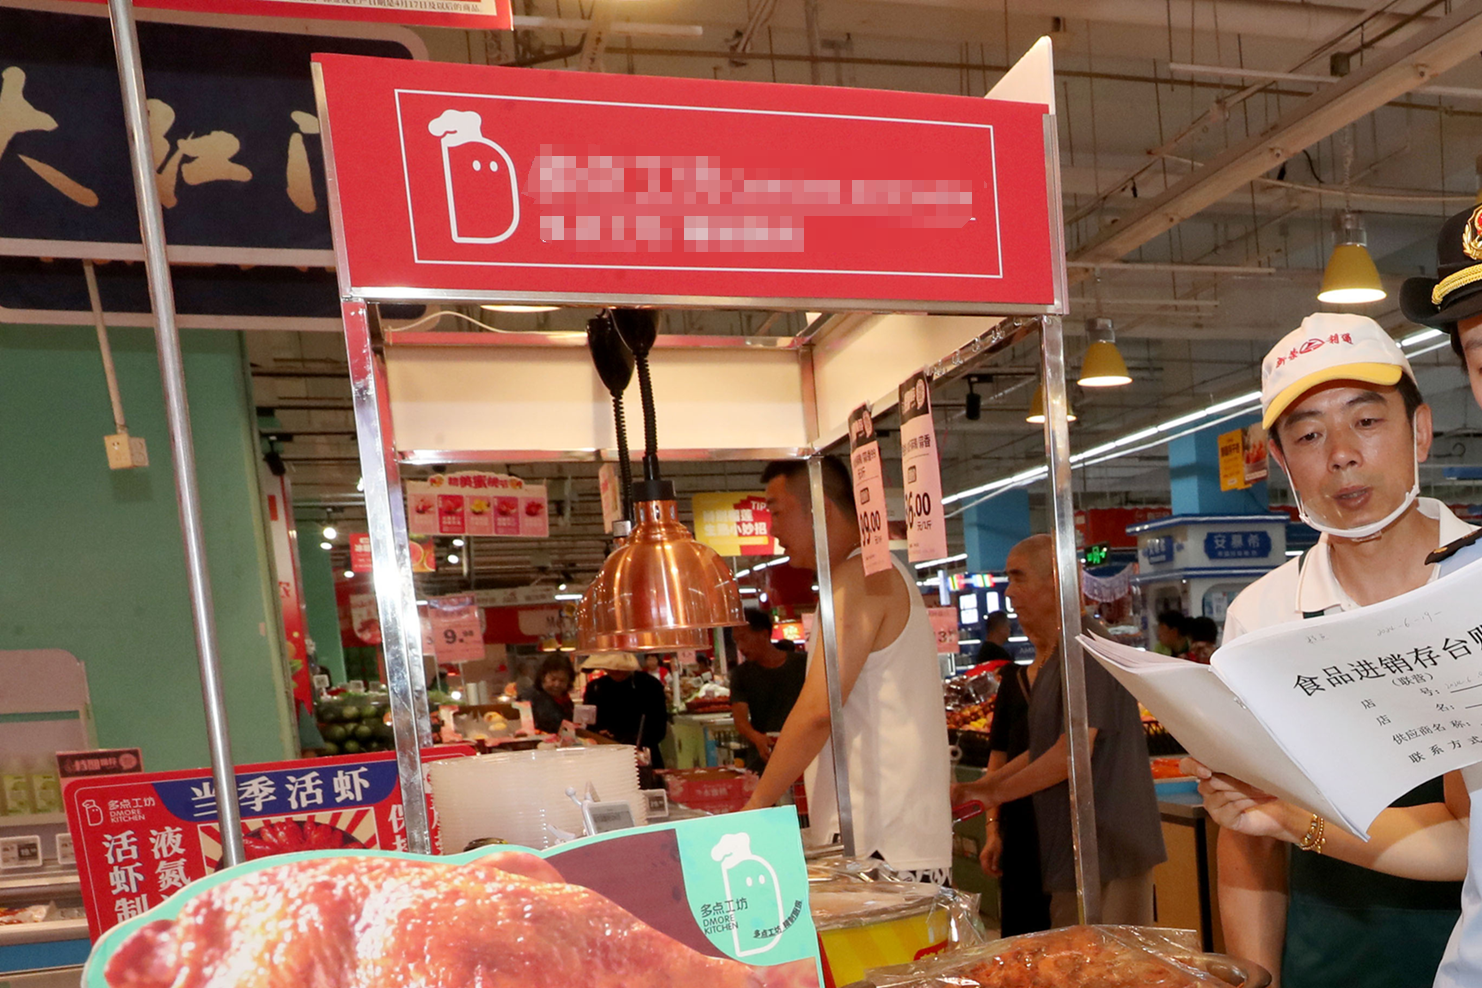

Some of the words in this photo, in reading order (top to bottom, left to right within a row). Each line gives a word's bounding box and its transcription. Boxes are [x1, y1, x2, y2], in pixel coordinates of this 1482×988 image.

[191, 766, 371, 818] 当季活虾
[107, 797, 156, 811] 多点工坊
[109, 808, 142, 818] DMORE
[110, 814, 146, 824] KITCHEN
[149, 826, 191, 903] 液氮
[701, 897, 748, 918] 多点工坊
[703, 914, 735, 928] DMORE
[704, 921, 739, 935] KITCHEN
